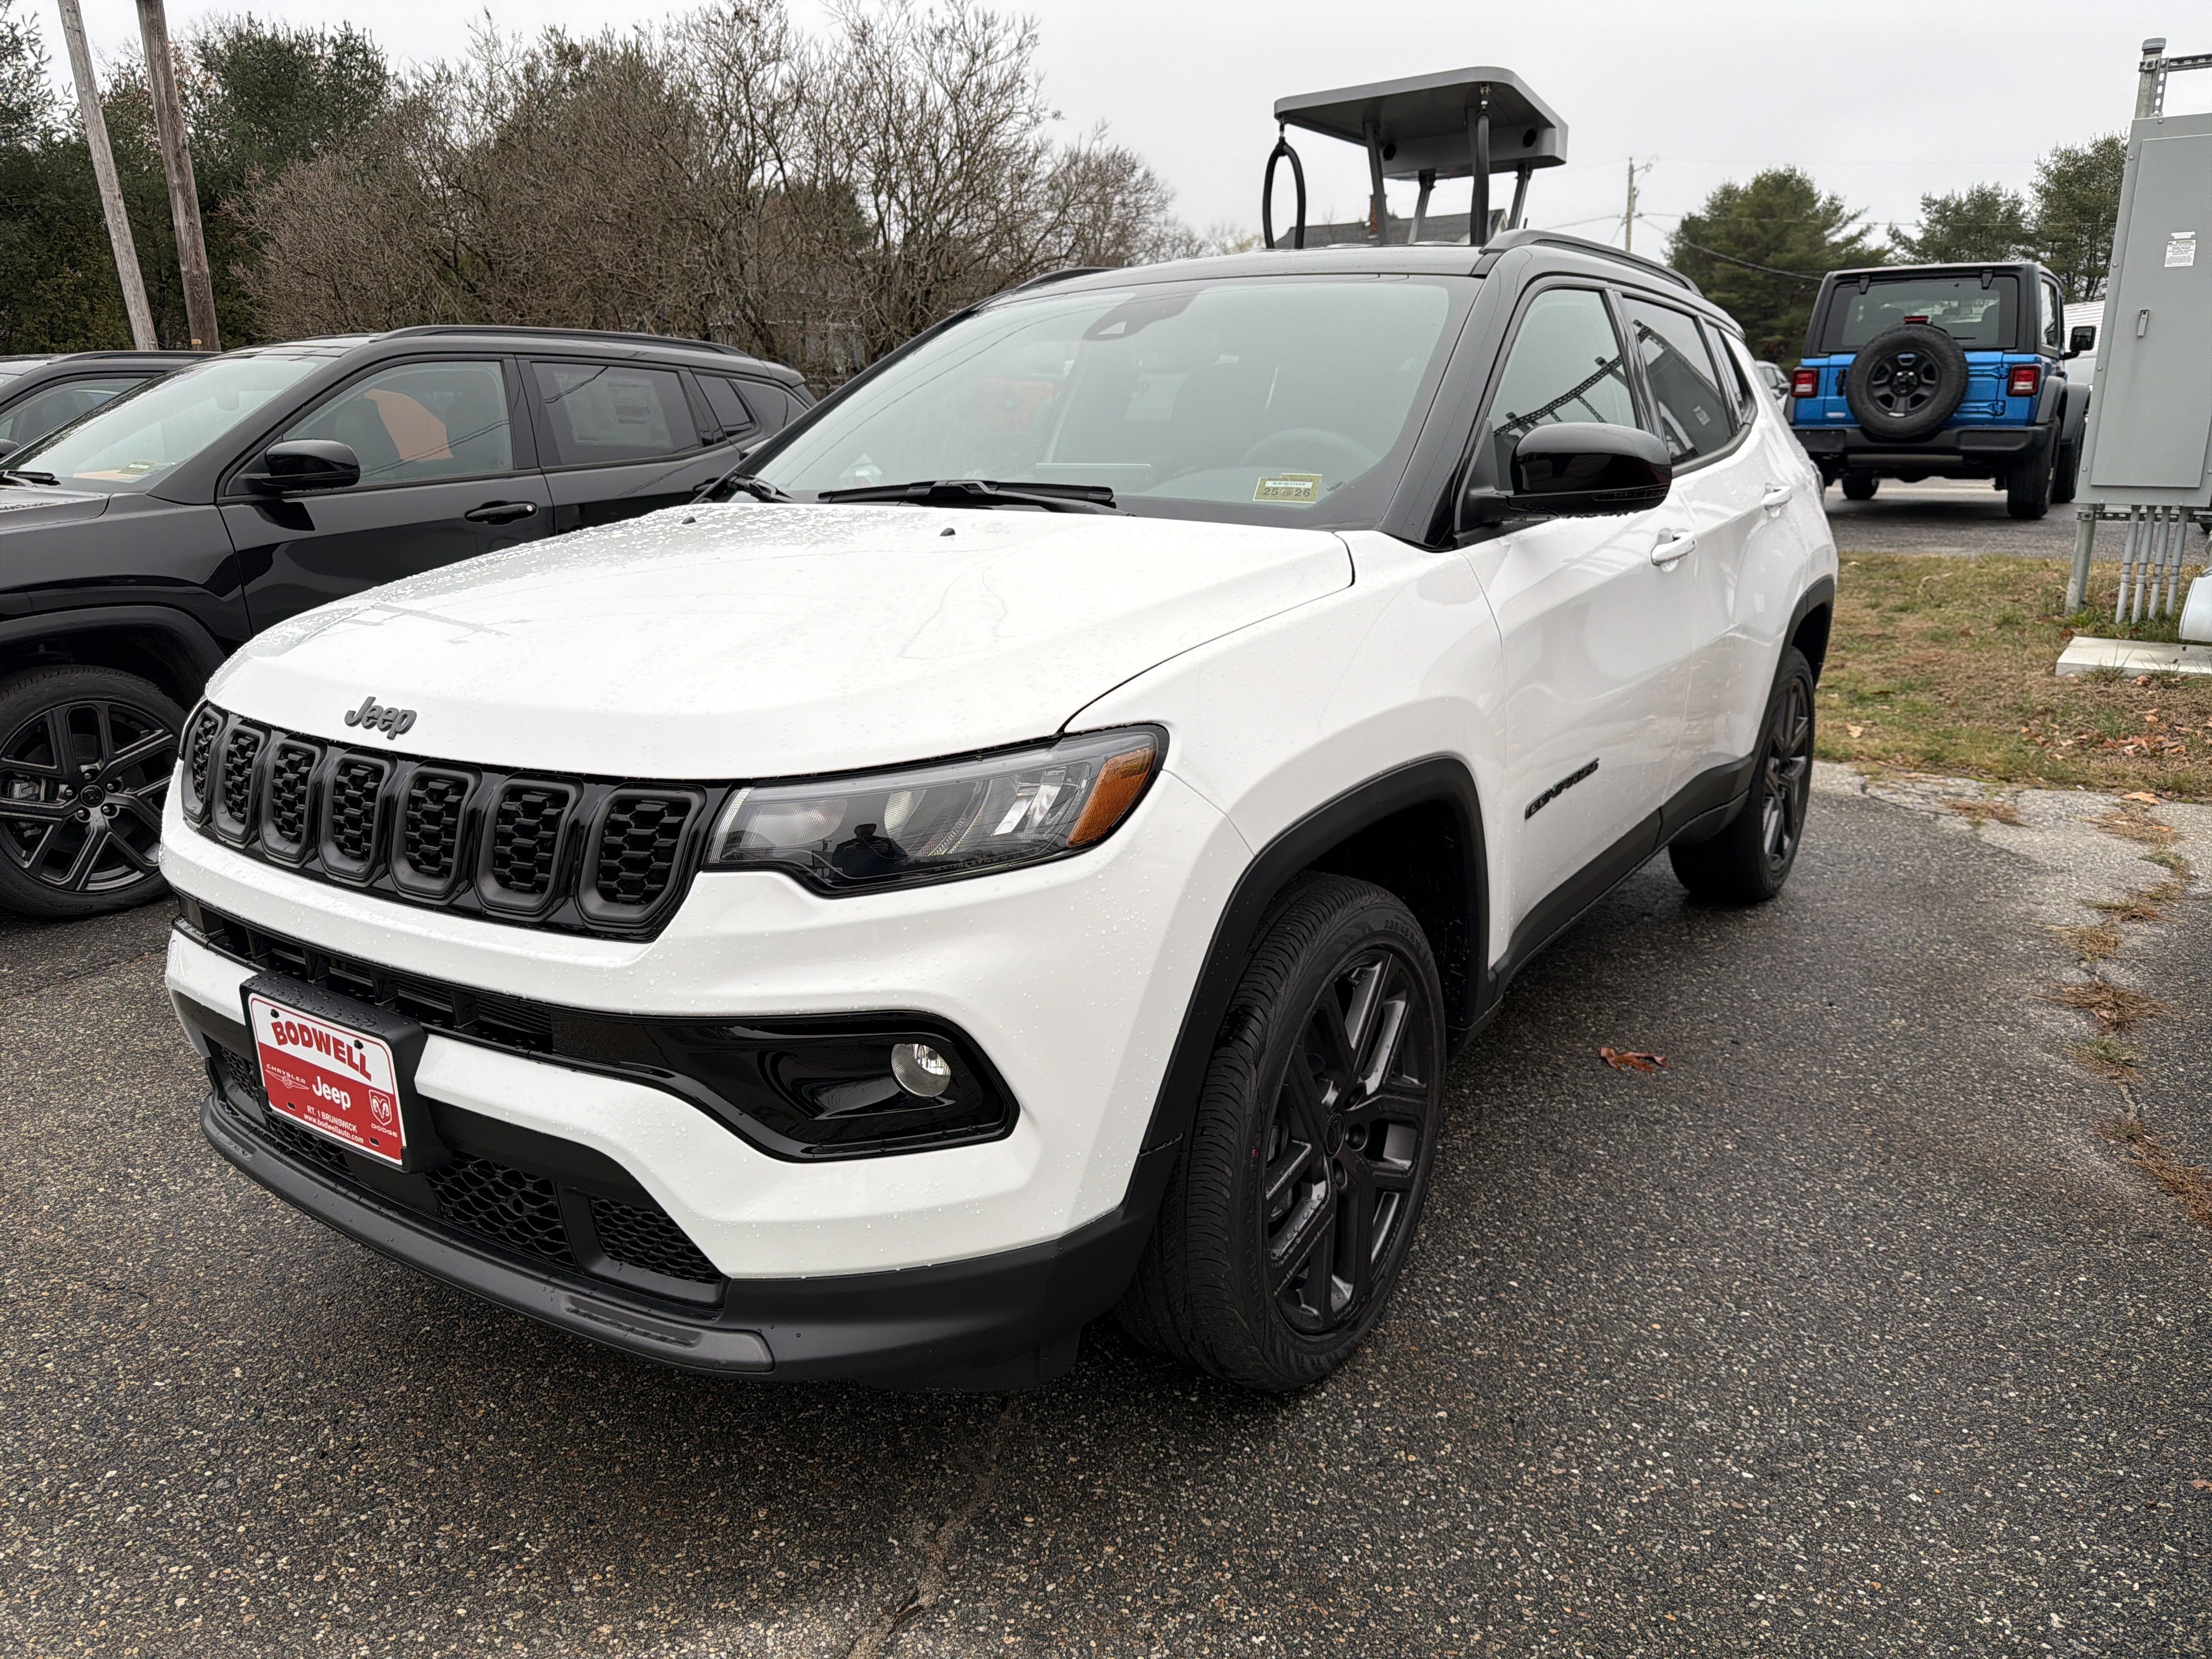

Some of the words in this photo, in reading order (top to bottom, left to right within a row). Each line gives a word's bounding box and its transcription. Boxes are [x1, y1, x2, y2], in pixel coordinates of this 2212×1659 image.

[1263, 488, 1279, 496] 25
[1294, 489, 1311, 497] 26
[344, 696, 417, 741] Jeep
[271, 1020, 372, 1082] BODWELL
[266, 1064, 306, 1084] CHRYSLER
[312, 1075, 351, 1110] Jeep
[303, 1113, 364, 1144] www.bodwellauto.com
[307, 1105, 316, 1116] RT.
[317, 1109, 321, 1118] 1
[321, 1111, 358, 1133] BRUNSWICK
[371, 1122, 398, 1138] DODGE
